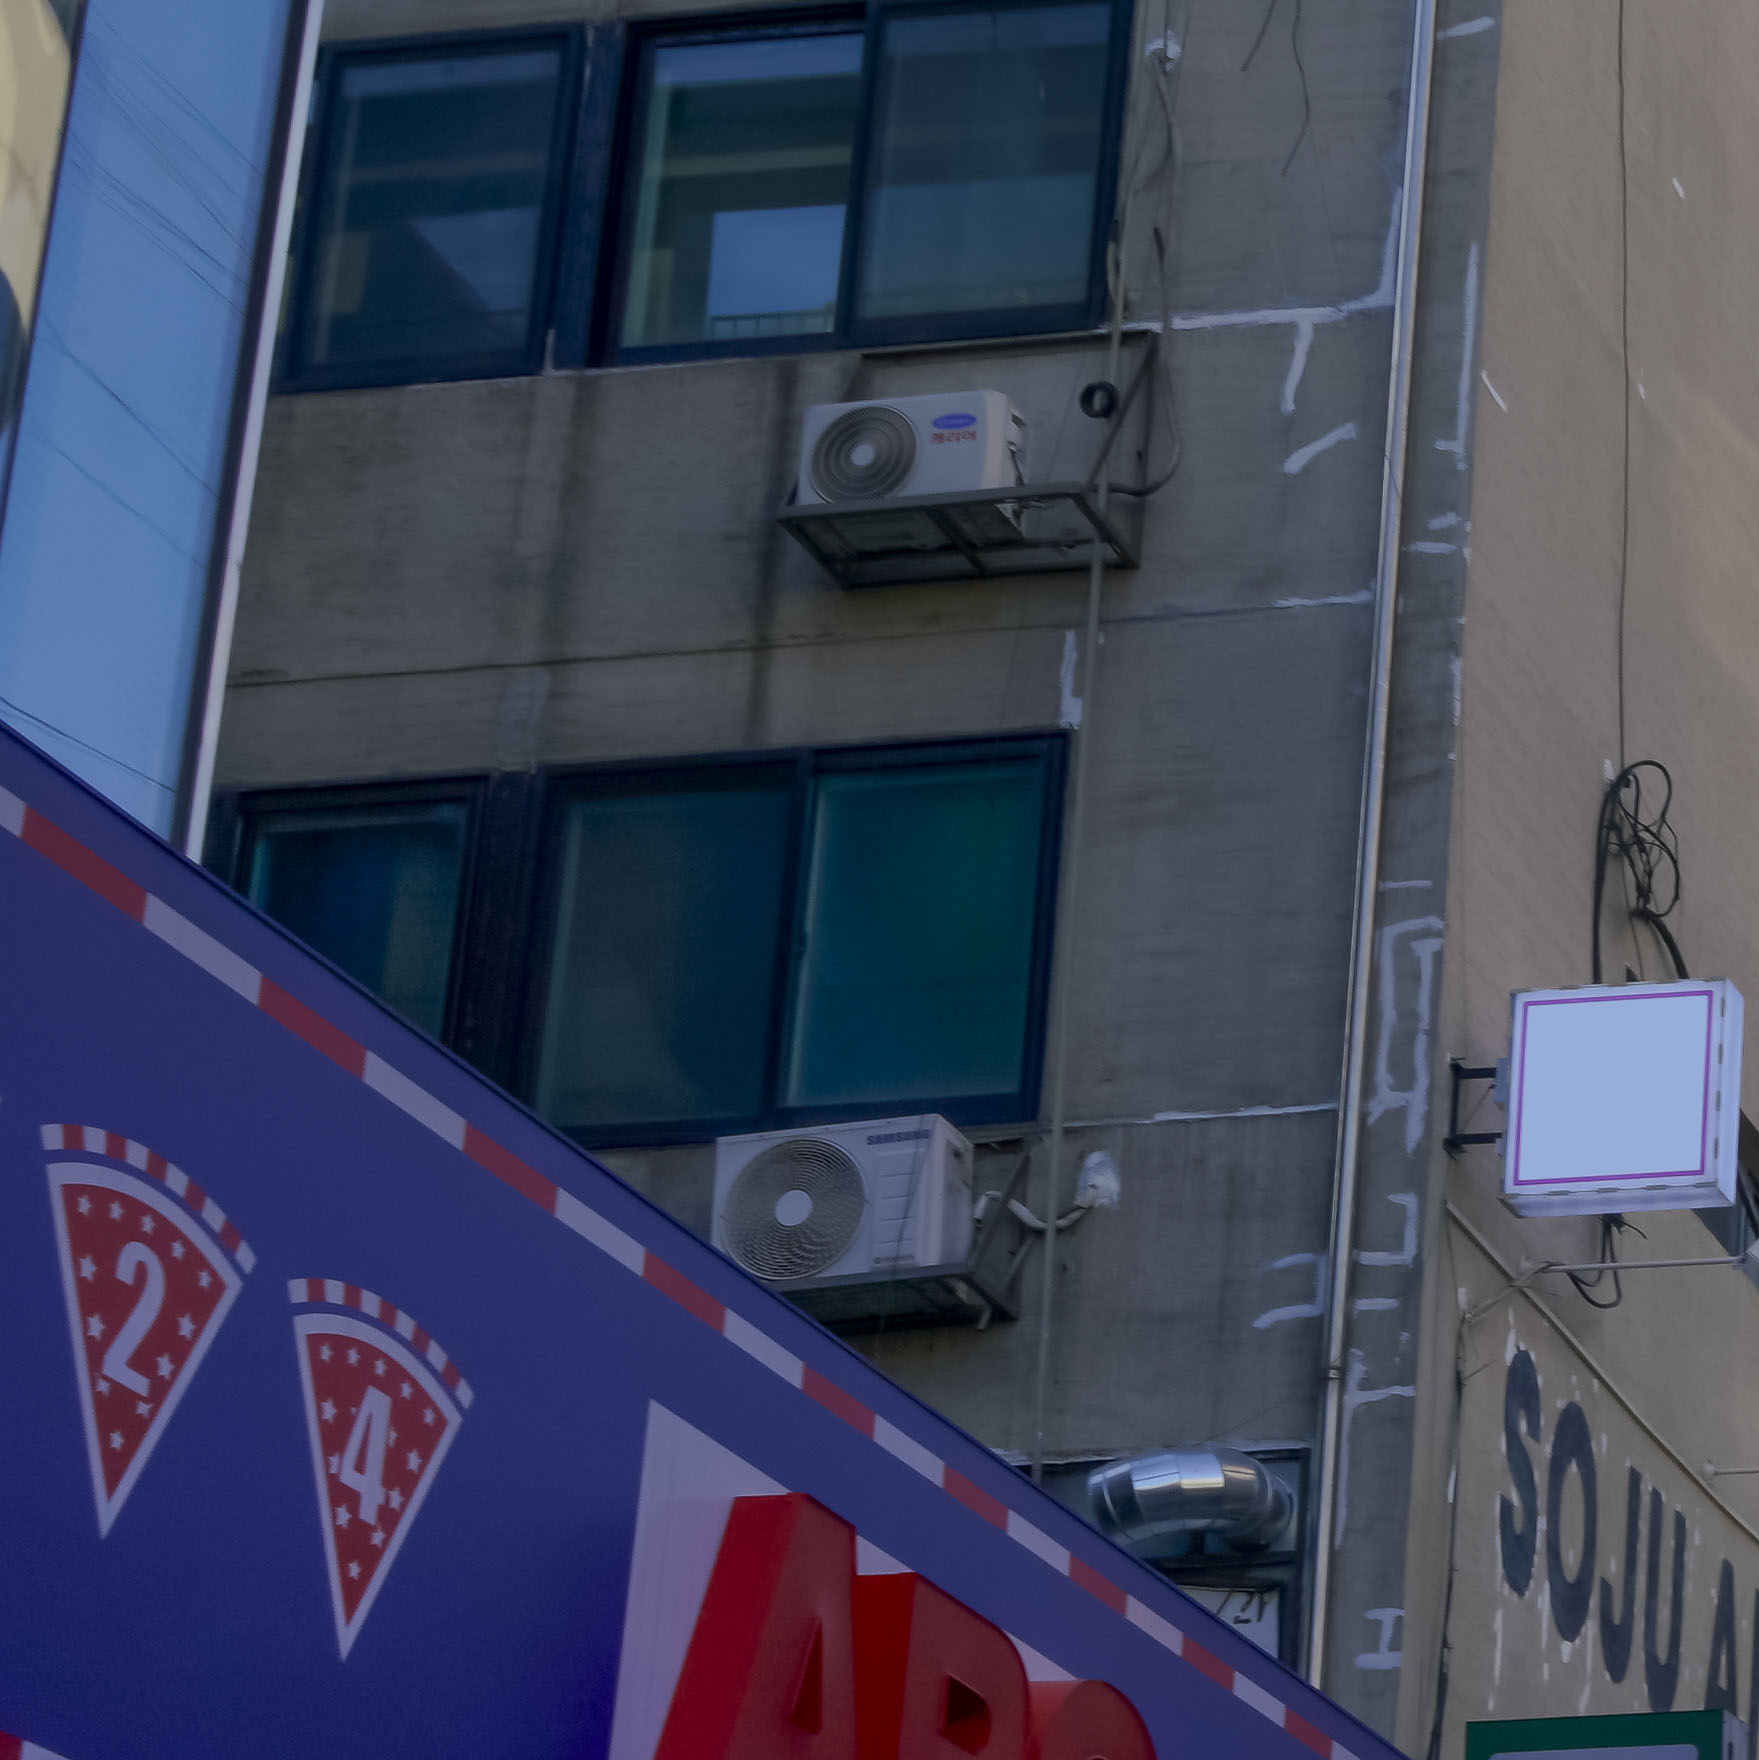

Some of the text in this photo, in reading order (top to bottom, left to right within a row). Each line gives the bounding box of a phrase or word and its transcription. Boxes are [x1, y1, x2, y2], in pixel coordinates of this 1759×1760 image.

[99, 1240, 167, 1398] 2
[338, 1384, 396, 1526] 4
[1498, 1345, 1688, 1713] SOJU
